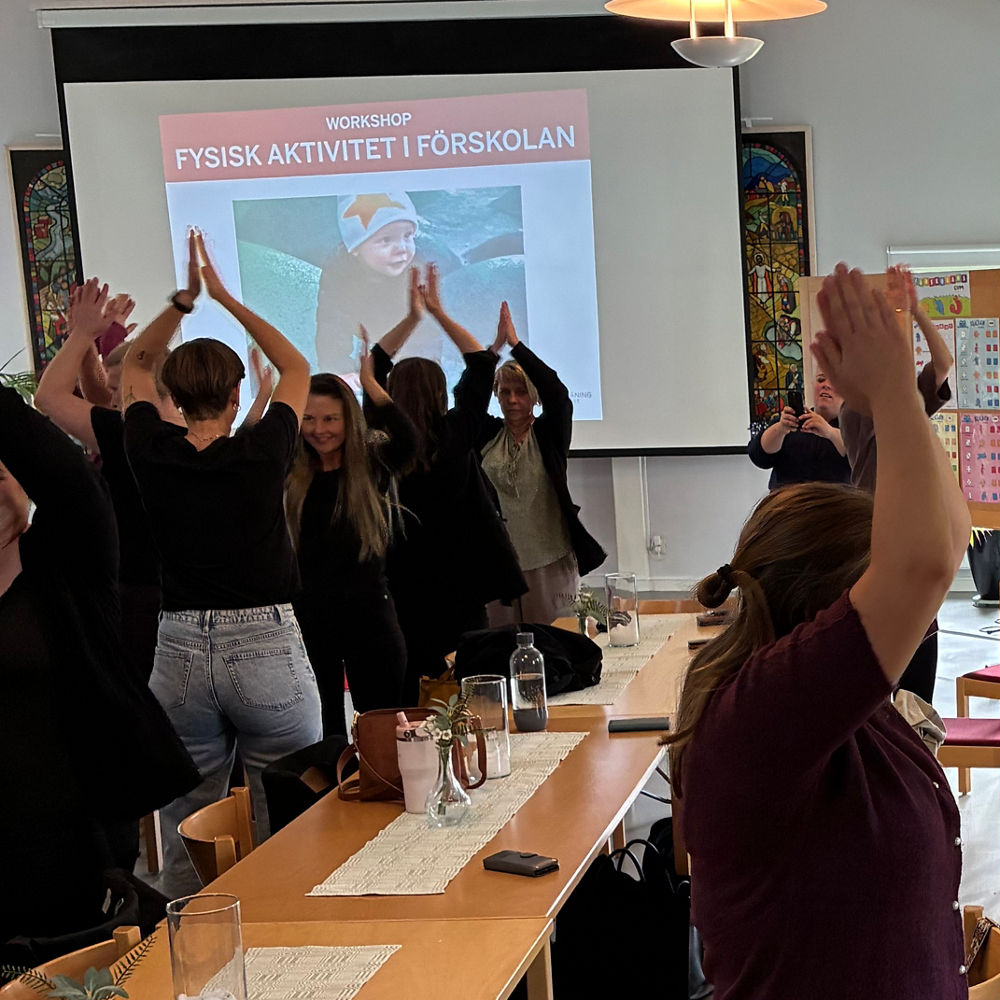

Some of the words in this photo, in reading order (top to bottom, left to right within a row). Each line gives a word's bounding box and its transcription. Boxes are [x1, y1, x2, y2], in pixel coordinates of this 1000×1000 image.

[326, 112, 412, 130] WORKSHOP
[175, 144, 263, 170] FYSISK
[267, 136, 397, 165] AKTIVITET
[403, 135, 410, 158] I
[416, 125, 576, 157] FÖRSKOLAN
